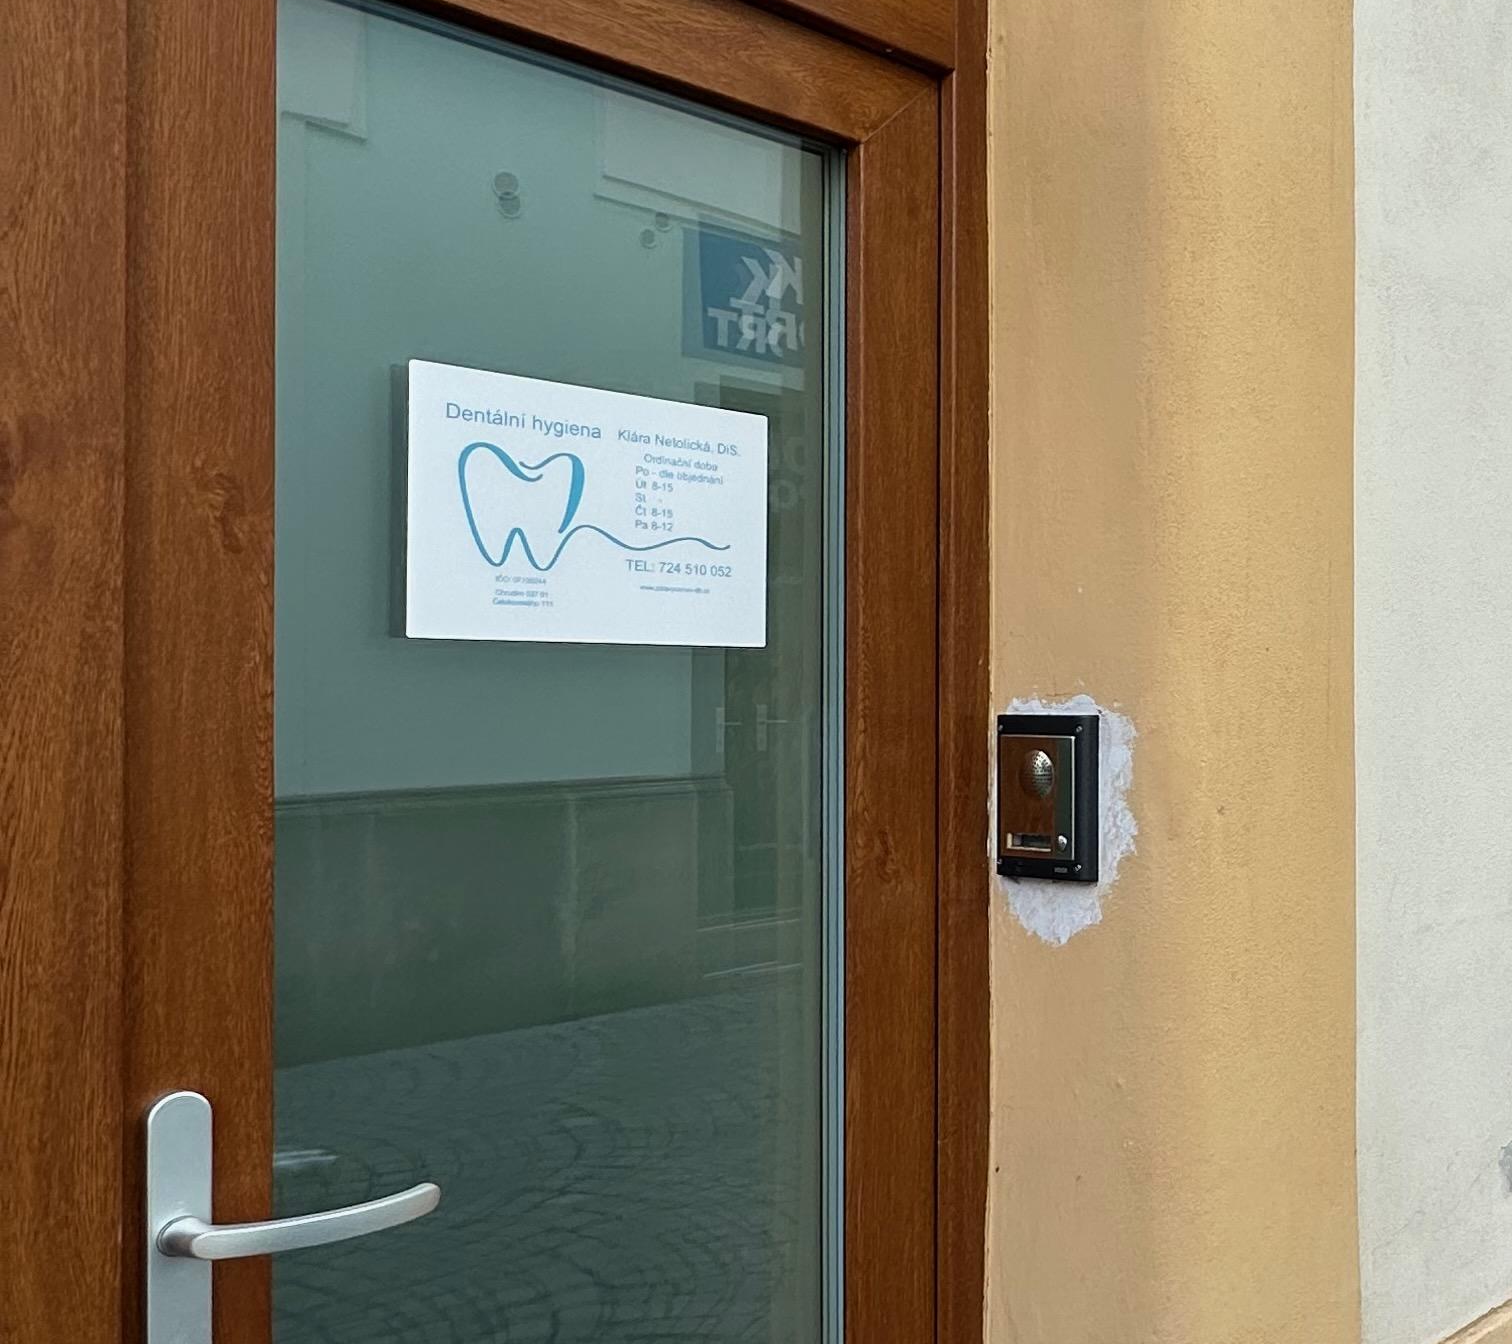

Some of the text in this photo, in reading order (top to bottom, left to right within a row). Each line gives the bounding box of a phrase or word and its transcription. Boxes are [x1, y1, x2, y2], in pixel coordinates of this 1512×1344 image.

[446, 402, 602, 439] Dentální hygiena
[618, 429, 651, 444] Klára
[635, 465, 650, 476] Po
[651, 480, 674, 493] 8-15
[659, 561, 681, 574] 724
[684, 563, 708, 576] 510
[710, 565, 733, 577] 052
